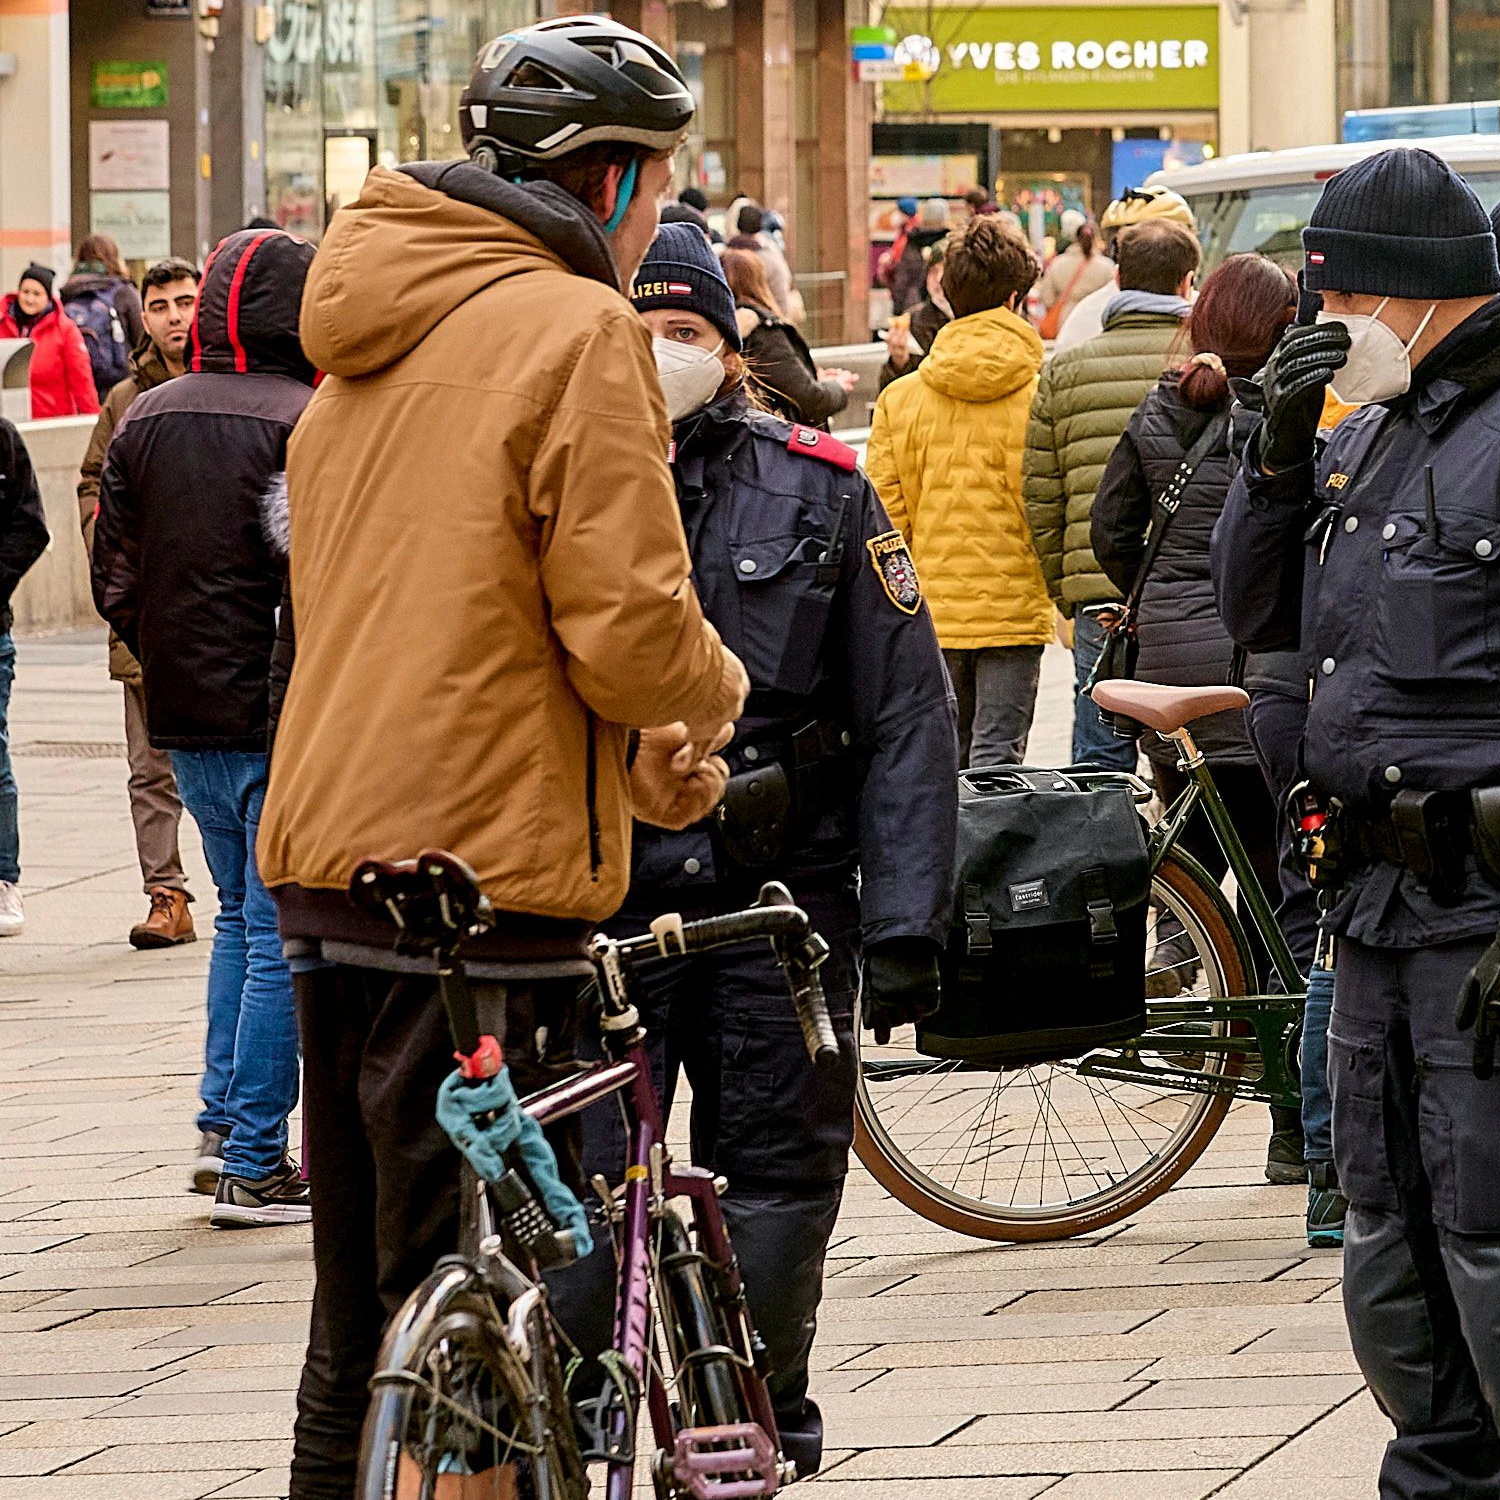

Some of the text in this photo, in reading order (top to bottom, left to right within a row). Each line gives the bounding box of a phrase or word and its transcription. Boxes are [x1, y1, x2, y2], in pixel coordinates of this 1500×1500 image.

[947, 39, 1209, 71] YVES ROCHER
[629, 281, 668, 300] LIZEI
